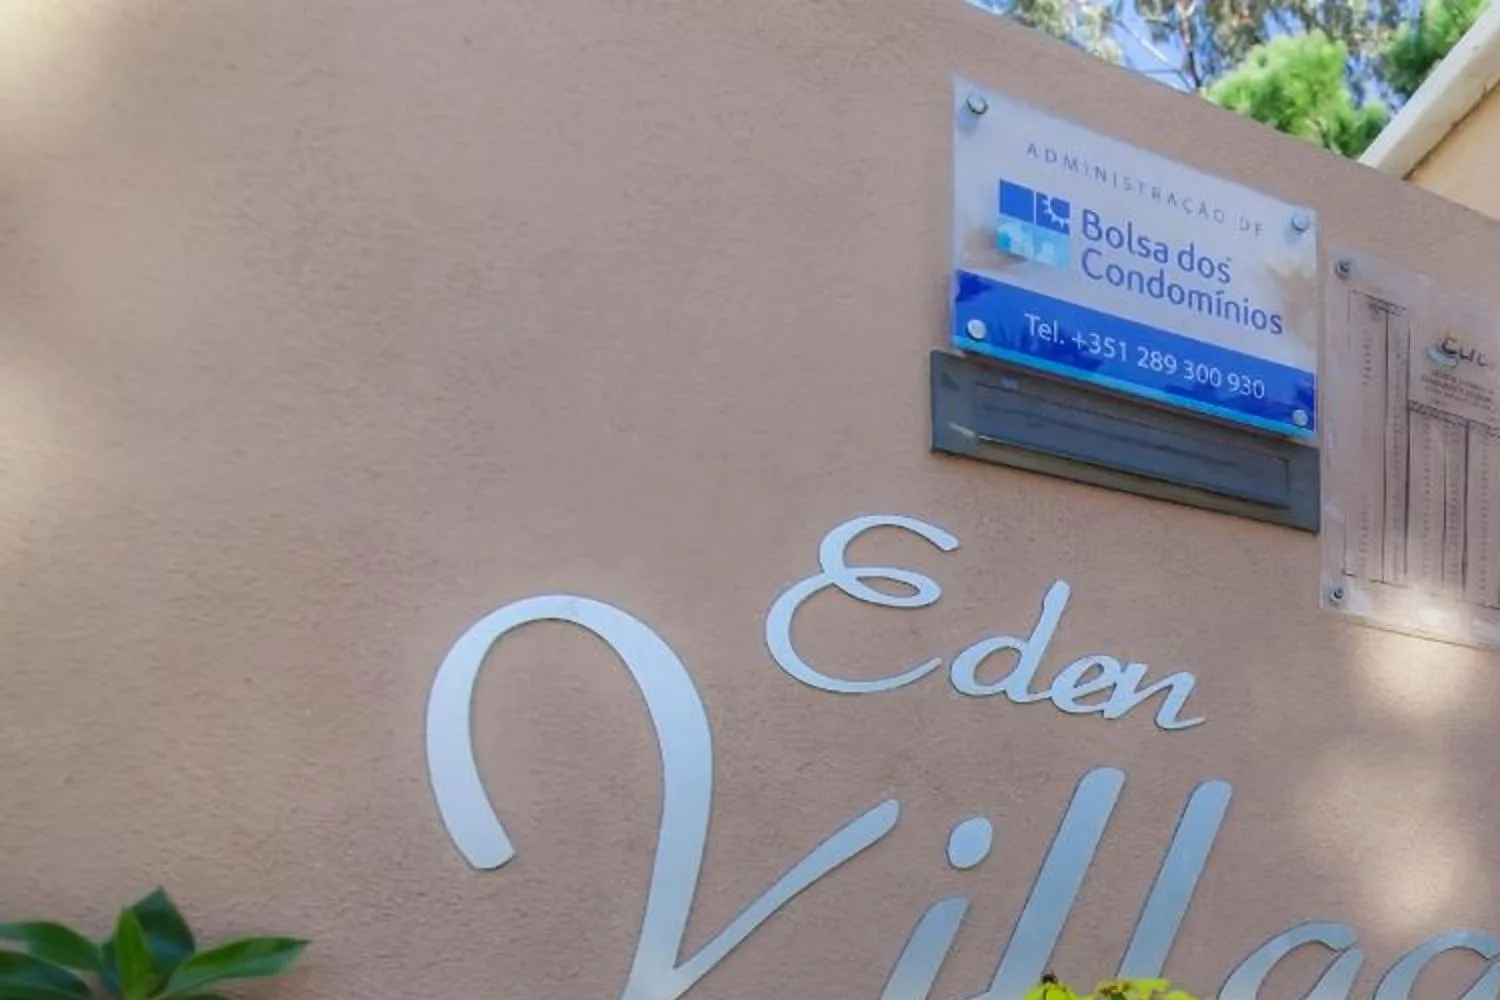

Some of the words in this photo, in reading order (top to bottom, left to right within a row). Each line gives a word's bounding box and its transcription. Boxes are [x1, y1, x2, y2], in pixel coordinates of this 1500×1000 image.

[1081, 208, 1169, 264] Bolsa
[1177, 243, 1231, 285] dos
[1081, 248, 1283, 335] Condomínios
[1024, 312, 1065, 346] Tel.
[1071, 331, 1128, 362] +351
[1137, 345, 1177, 375] 289
[1183, 357, 1221, 387] 300
[1227, 371, 1265, 400] 930
[765, 513, 1206, 731] Eden
